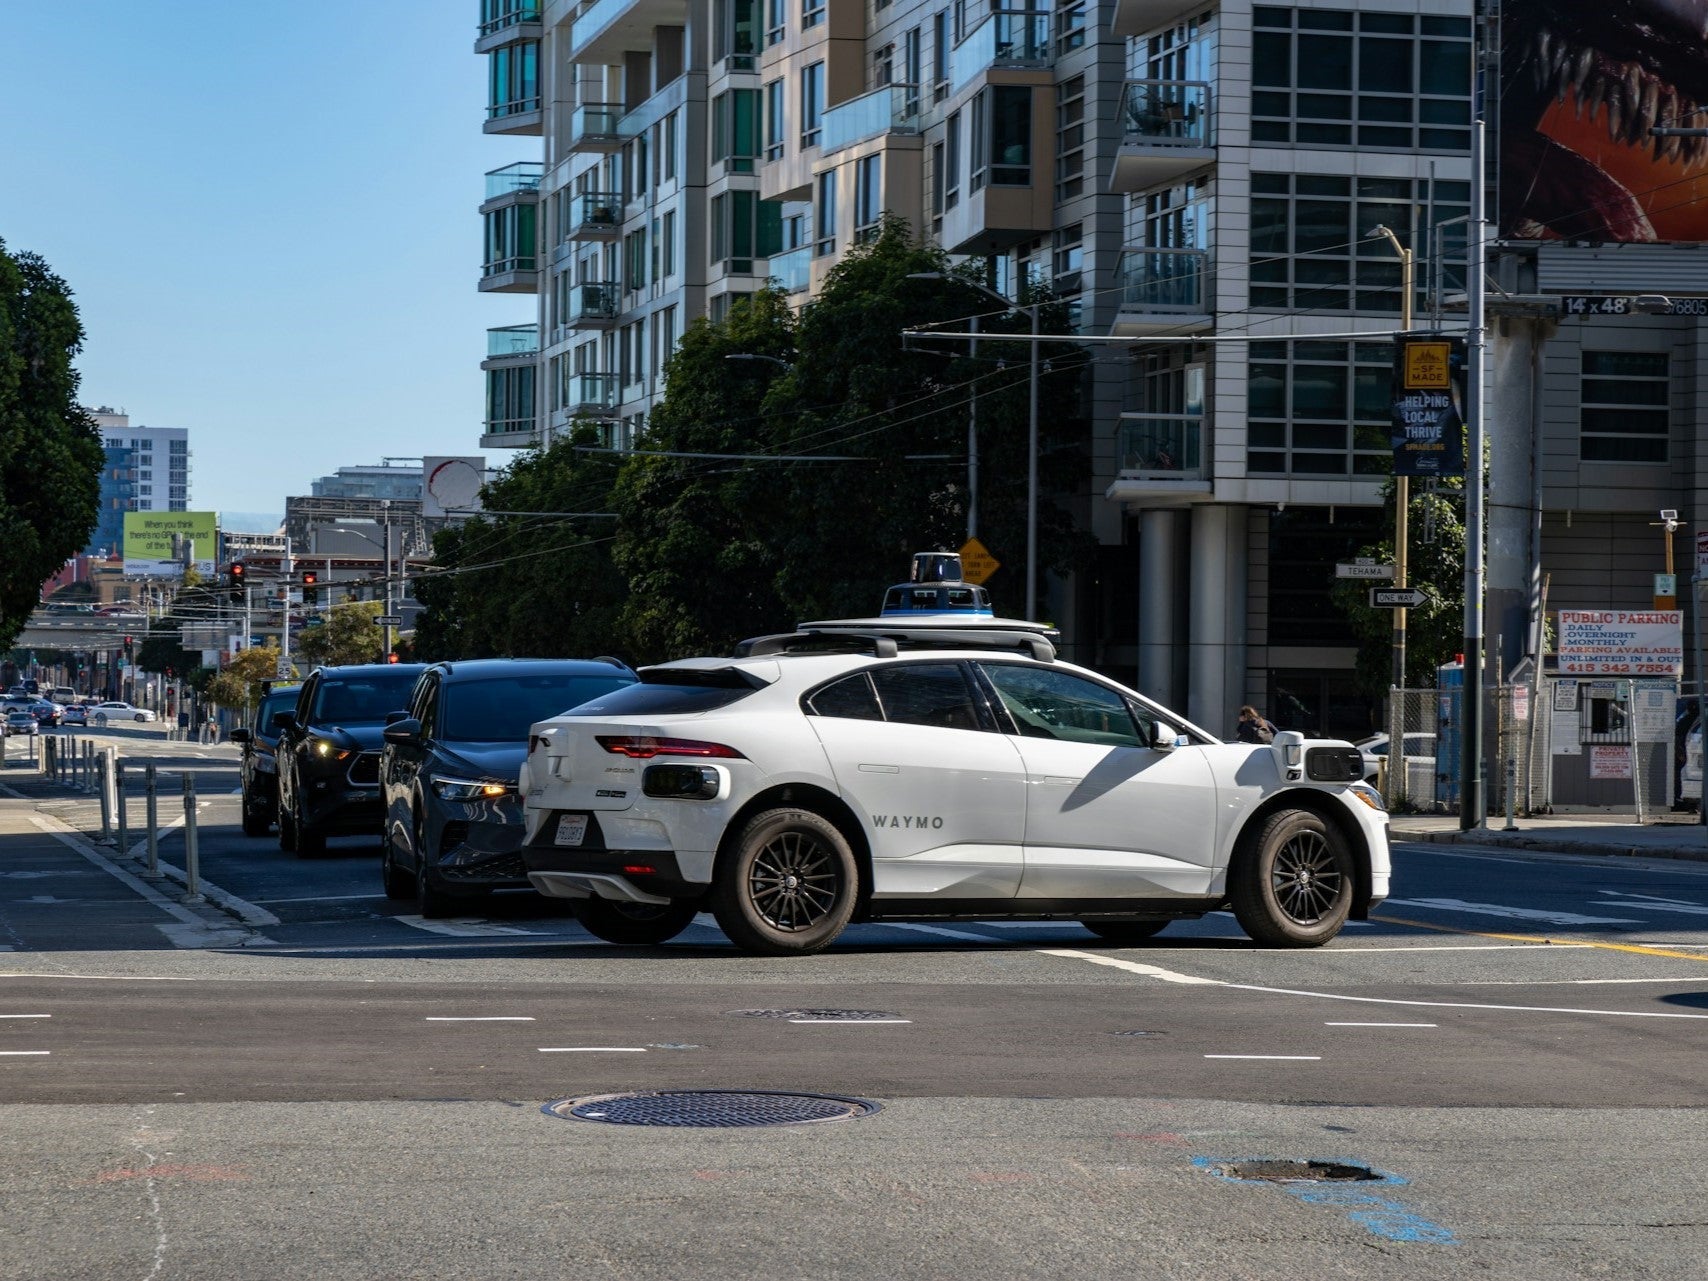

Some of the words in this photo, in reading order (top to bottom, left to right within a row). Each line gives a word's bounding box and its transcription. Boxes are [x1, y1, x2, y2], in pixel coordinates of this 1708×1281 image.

[1421, 365, 1434, 373] SF
[1412, 373, 1443, 381] MADE
[1405, 395, 1449, 408] HELPING
[1405, 411, 1437, 423] LOCAL
[1405, 426, 1442, 439] THRIVE
[144, 520, 162, 529] When
[164, 521, 176, 530] you
[177, 520, 194, 529] think
[129, 531, 152, 539] there's
[196, 531, 209, 539] end
[146, 541, 153, 550] of
[154, 541, 166, 550] the
[1348, 567, 1383, 576] TEHAMA
[1380, 593, 1395, 601] ONE
[1397, 593, 1414, 601] WAY
[1561, 612, 1614, 625] PUBLIC
[1618, 613, 1680, 625] PARKING
[1560, 646, 1613, 654] PARKING
[1630, 655, 1643, 663] IN
[1646, 655, 1654, 663] &
[278, 667, 291, 675] 25
[1567, 663, 1596, 673] 415
[1601, 663, 1630, 673] 342
[1636, 663, 1675, 673] 7554
[872, 814, 944, 829] WAYMO
